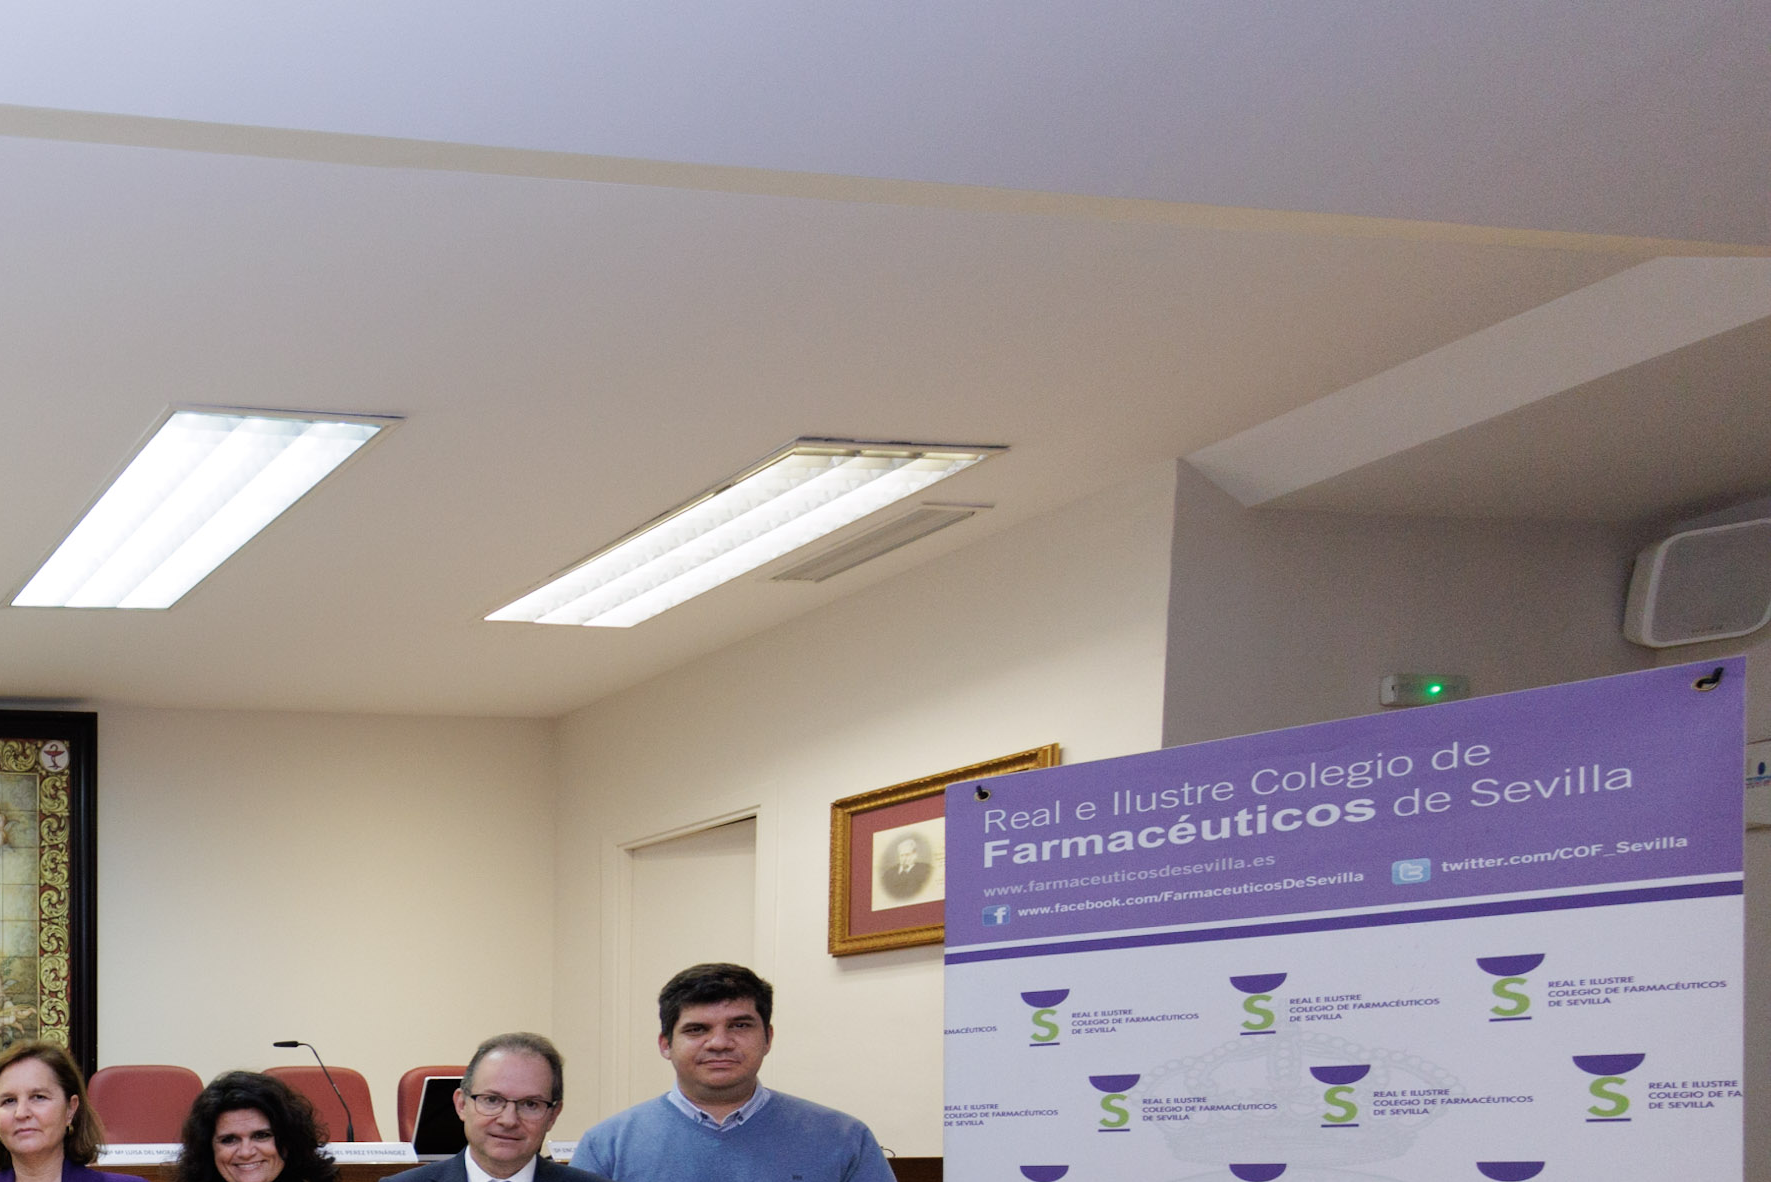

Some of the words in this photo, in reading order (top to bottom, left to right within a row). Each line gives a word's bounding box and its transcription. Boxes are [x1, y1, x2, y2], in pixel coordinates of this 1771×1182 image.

[983, 802, 1060, 835] Real
[1075, 798, 1098, 822] e
[1113, 776, 1236, 816] Ilustre
[1250, 752, 1414, 796] Colegio
[1431, 740, 1492, 771] de
[983, 797, 1377, 869] Farmacéuticos
[1392, 788, 1454, 818] de
[1470, 763, 1633, 808] Sevilla
[1441, 836, 1689, 873] twitter.com/COF_Sevilla
[983, 854, 1277, 898] www.farmaceuticosdesevilla.es
[1017, 871, 1365, 918] www.facebook.com/FarmaceuticosDeSevilla
[1548, 979, 1575, 987] REAL
[1589, 976, 1633, 985] ILUSTRE
[1548, 987, 1601, 997] COLEGIO
[1604, 986, 1619, 994] DE
[1623, 978, 1727, 993] FARMACÉUTICOS
[1324, 994, 1360, 1002] ILUSTRE
[1548, 999, 1562, 1007] DE
[1566, 996, 1611, 1005] SEVILLA
[1289, 1004, 1334, 1013] COLEGIO
[1352, 996, 1439, 1009] FARMACÉUTICOS
[1101, 1008, 1132, 1016] ILUSTRE
[1305, 1012, 1342, 1021] SEVILLA
[1071, 1018, 1109, 1026] COLEGIO
[1125, 1011, 1199, 1023] FARMACÉUTICOS
[1648, 1081, 1676, 1089] REAL
[1692, 1079, 1738, 1087] ILUSTRE
[1373, 1098, 1420, 1106] COLEGIO
[1440, 1094, 1533, 1104] FARMACÉUTICOS
[1647, 1090, 1704, 1099] COLEGIO
[1648, 1101, 1662, 1109] DE
[1667, 1100, 1715, 1108] SEVILLA
[1390, 1107, 1429, 1115] SEVILLA
